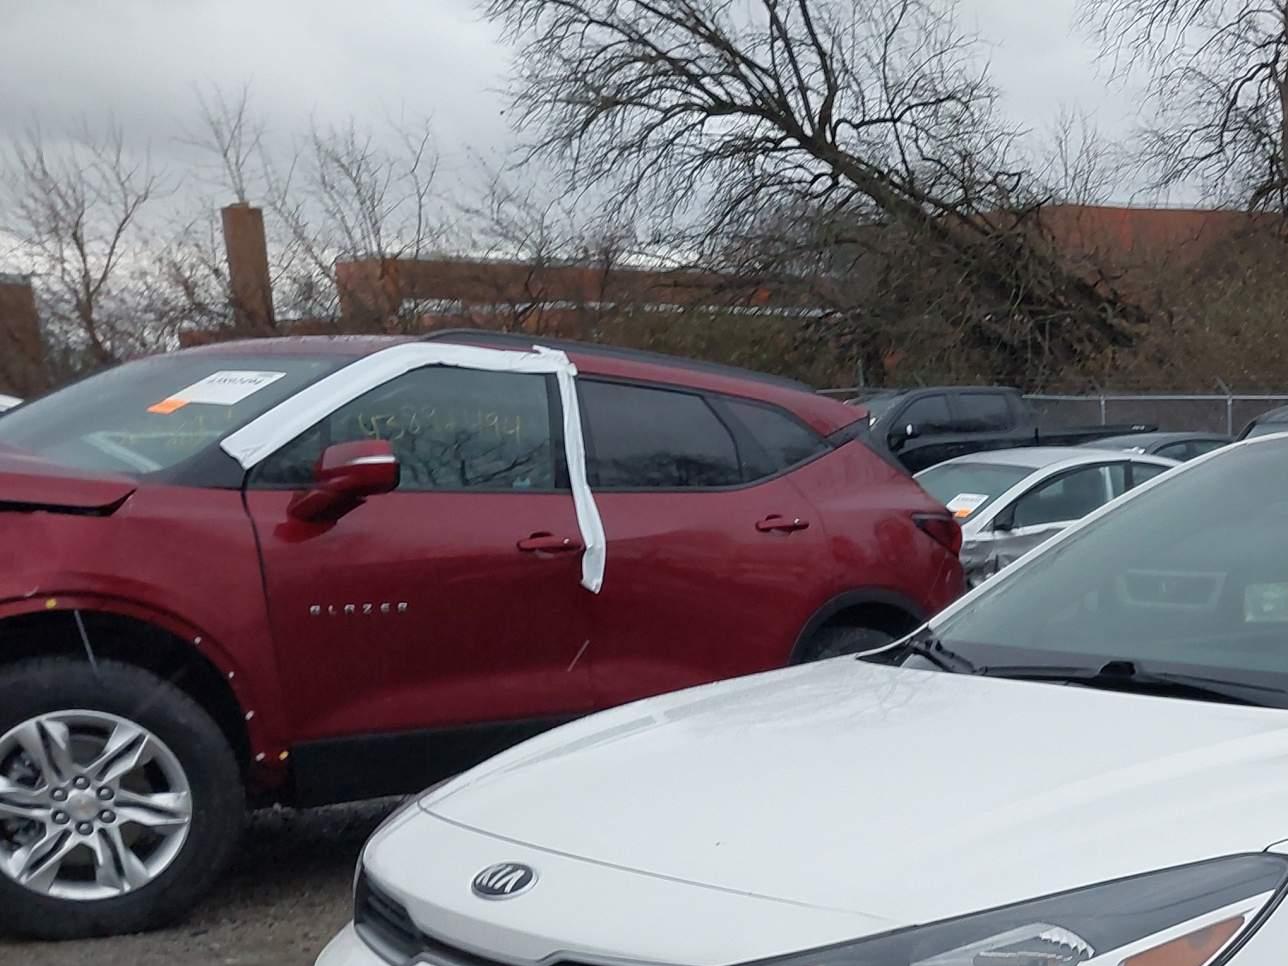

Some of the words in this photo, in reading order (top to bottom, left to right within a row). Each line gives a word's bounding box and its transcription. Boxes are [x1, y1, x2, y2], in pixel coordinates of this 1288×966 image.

[357, 405, 521, 440] 4389494
[309, 602, 408, 616] BLAZER
[474, 864, 526, 893] KIA
